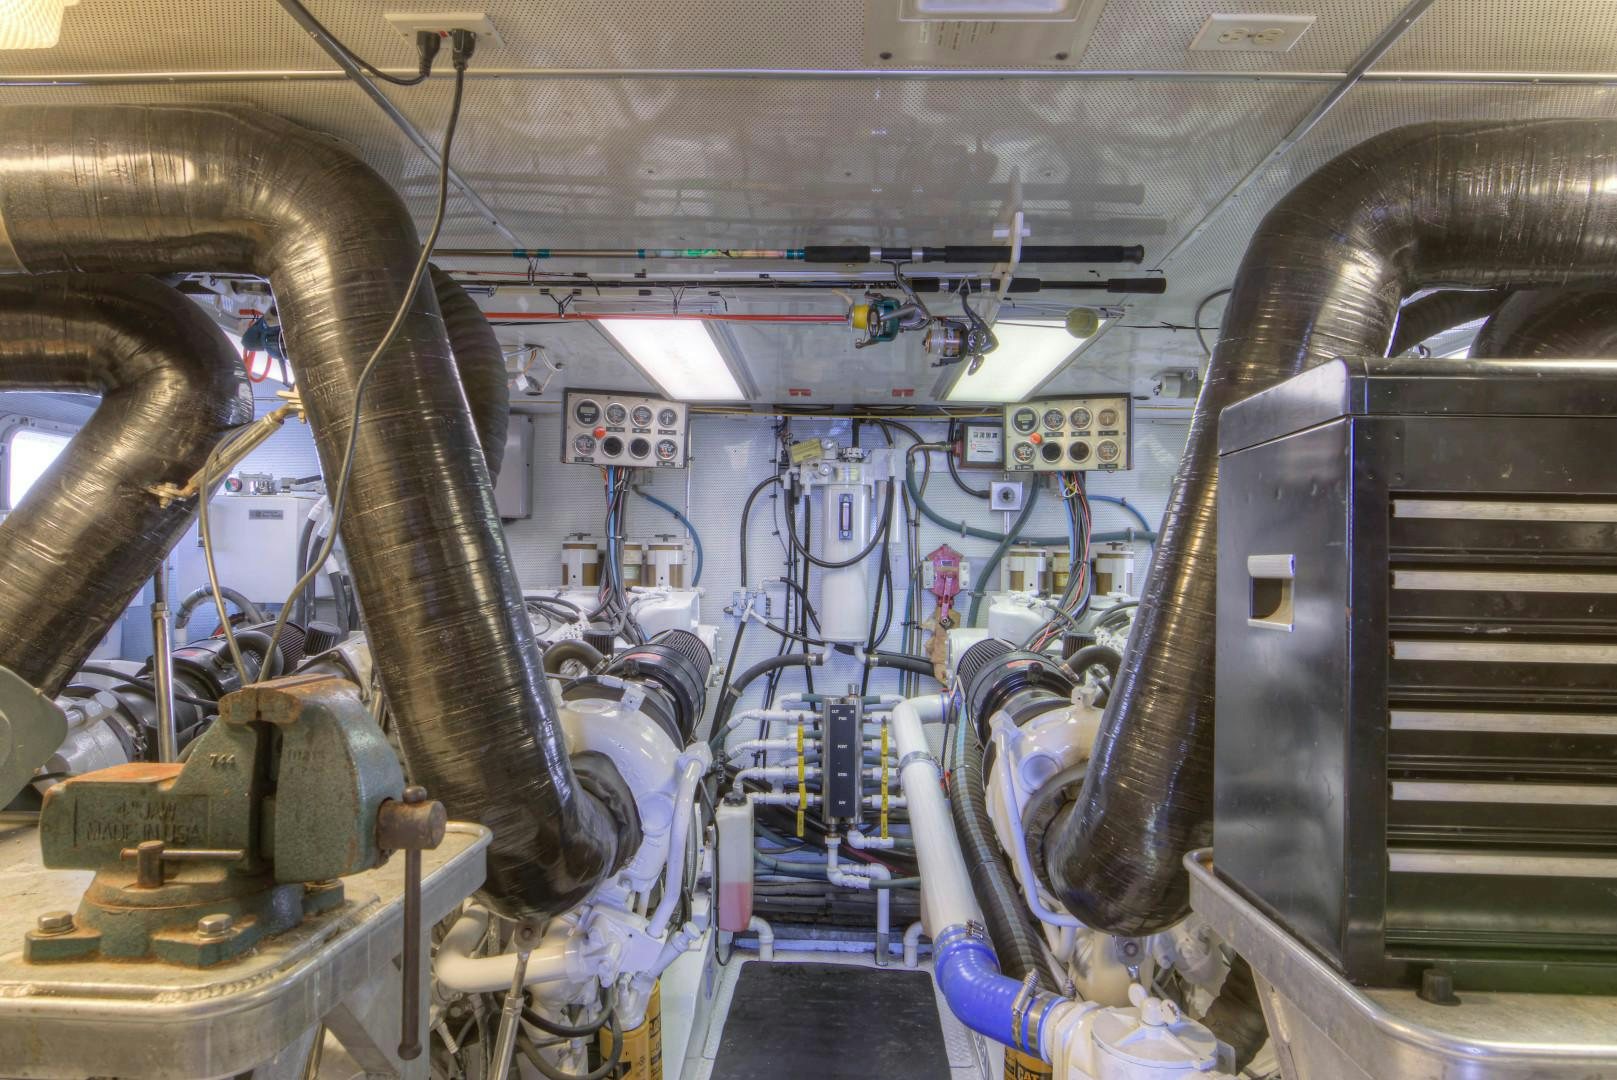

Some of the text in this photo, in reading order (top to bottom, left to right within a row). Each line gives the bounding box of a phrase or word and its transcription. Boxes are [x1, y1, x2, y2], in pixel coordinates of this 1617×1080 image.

[86, 822, 201, 844] MADE IN USA
